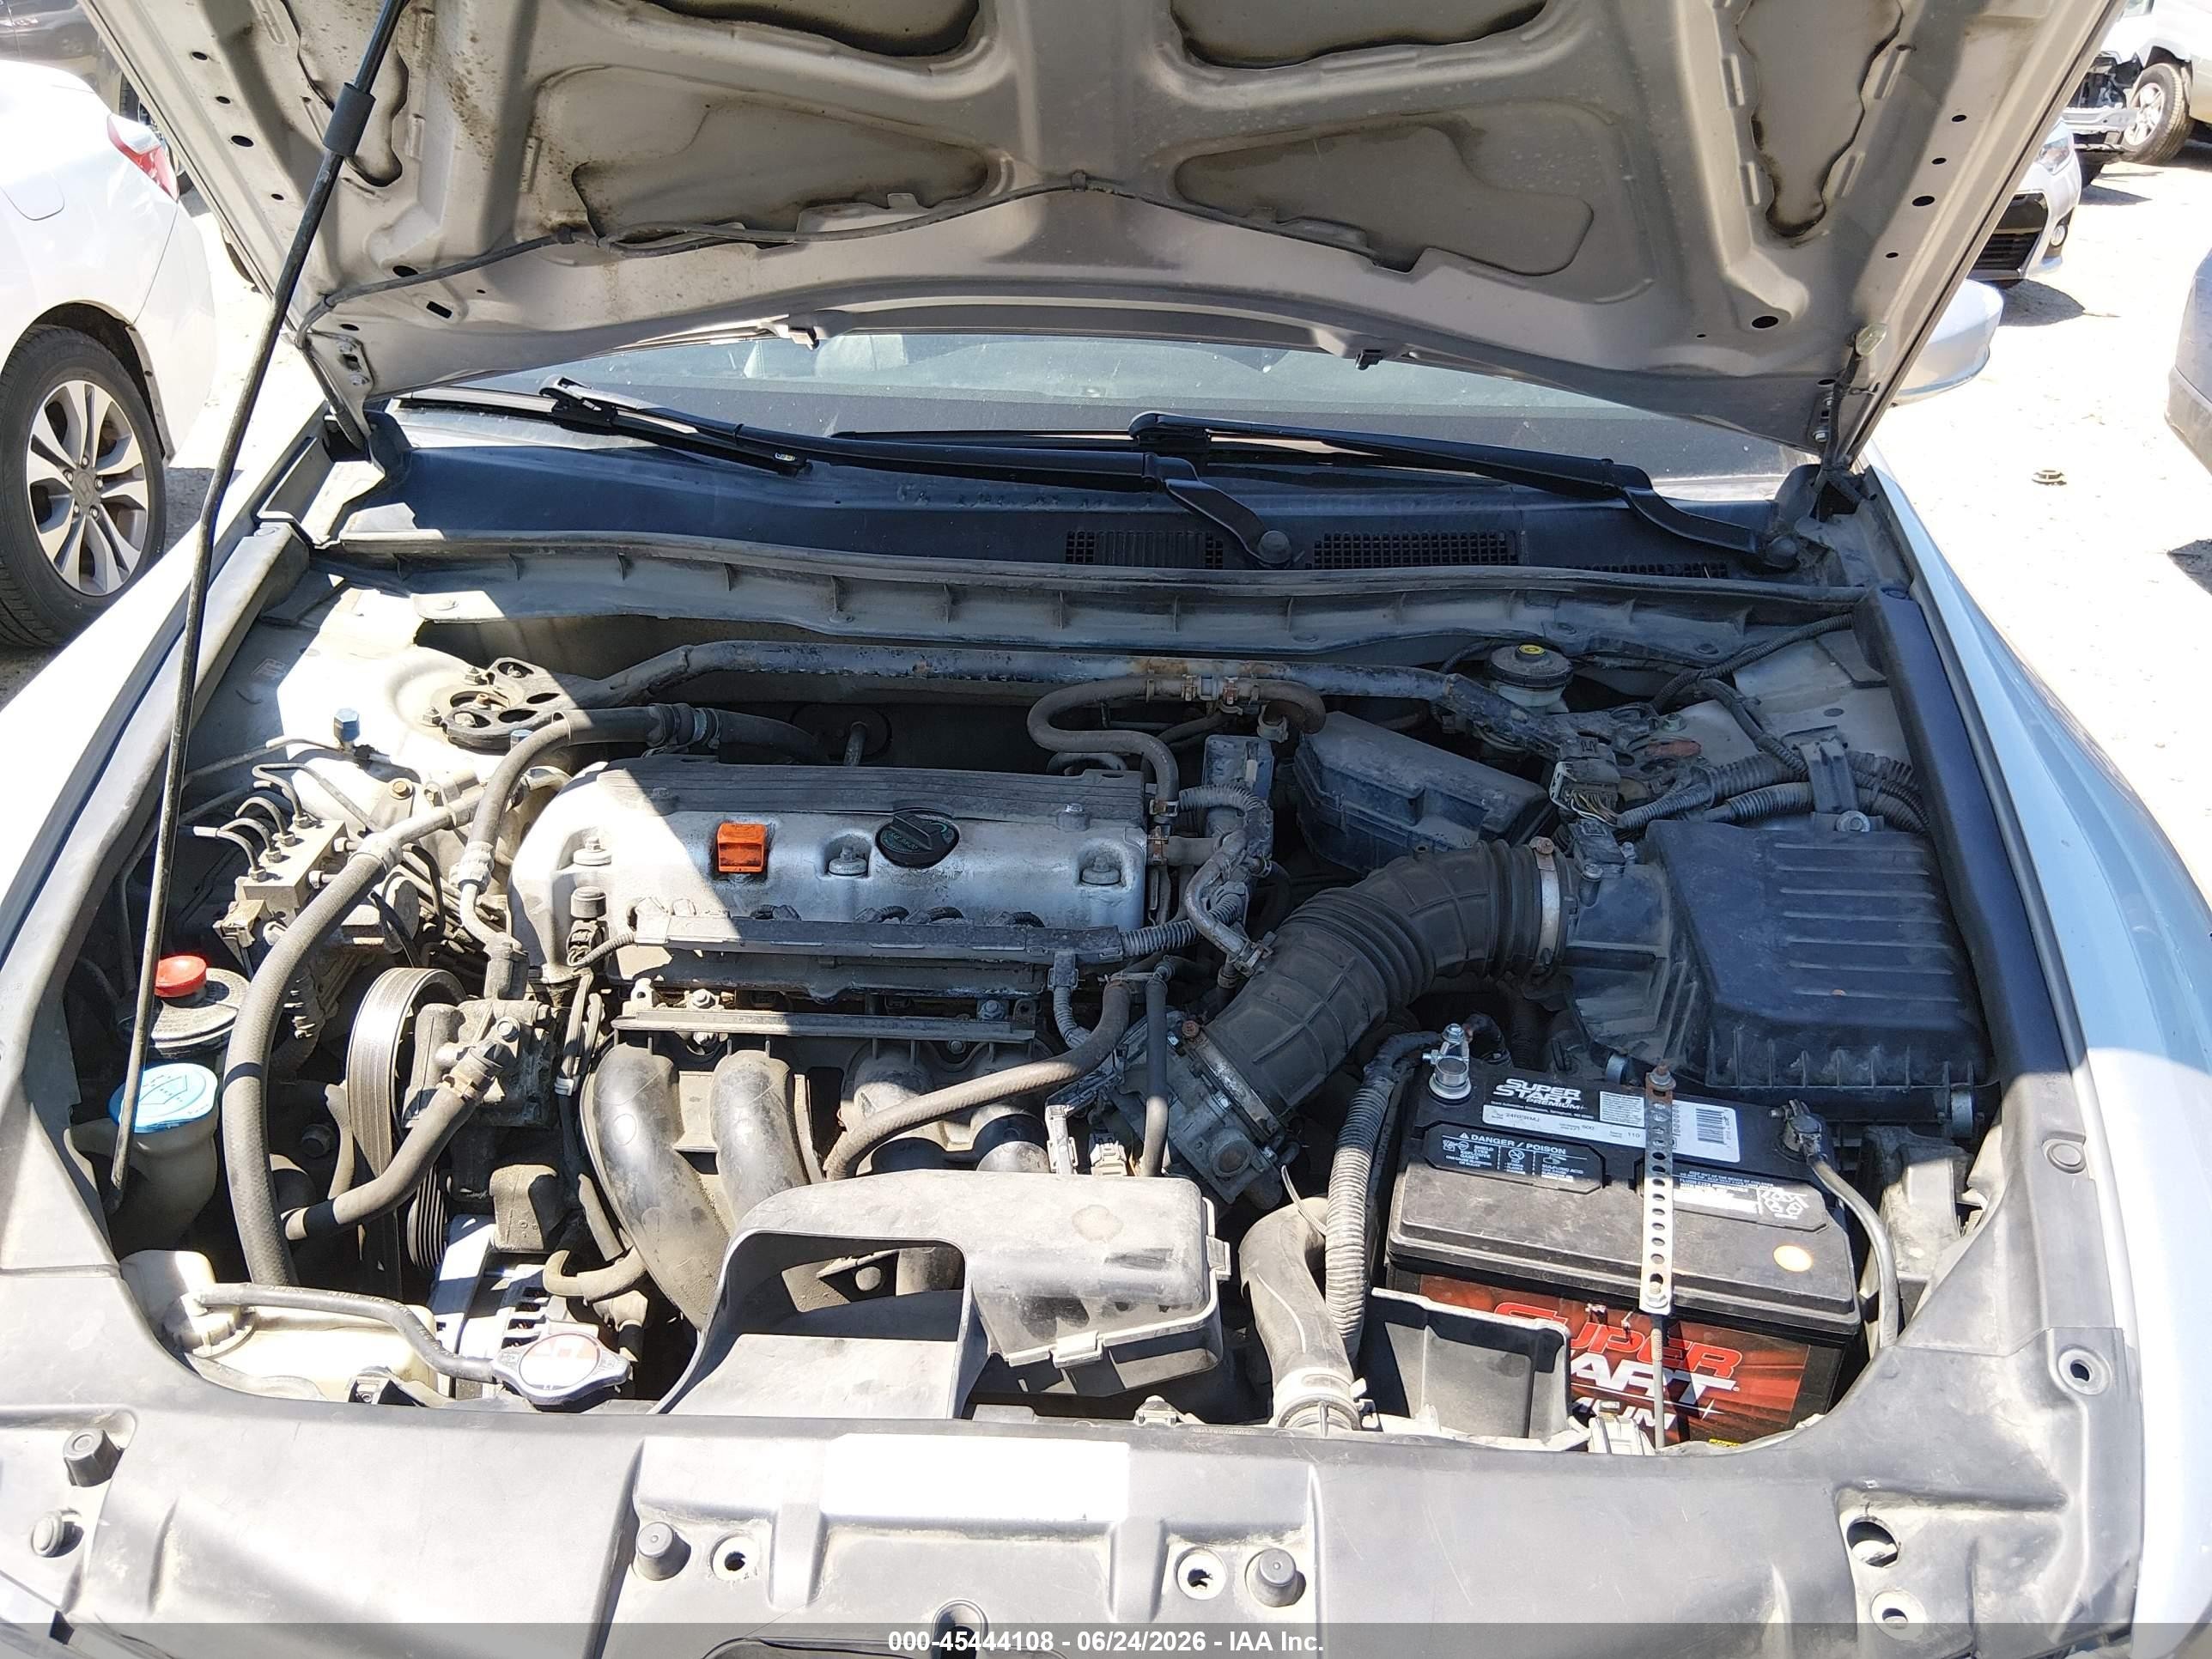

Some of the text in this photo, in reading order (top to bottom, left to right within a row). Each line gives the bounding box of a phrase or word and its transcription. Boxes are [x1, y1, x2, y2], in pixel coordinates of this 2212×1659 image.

[1492, 1084, 1582, 1104] START
[1505, 1078, 1583, 1097] SUPER
[1525, 1097, 1582, 1110] PREMIUM
[1471, 1133, 1516, 1147] DANGER
[1526, 1143, 1566, 1155] POISON
